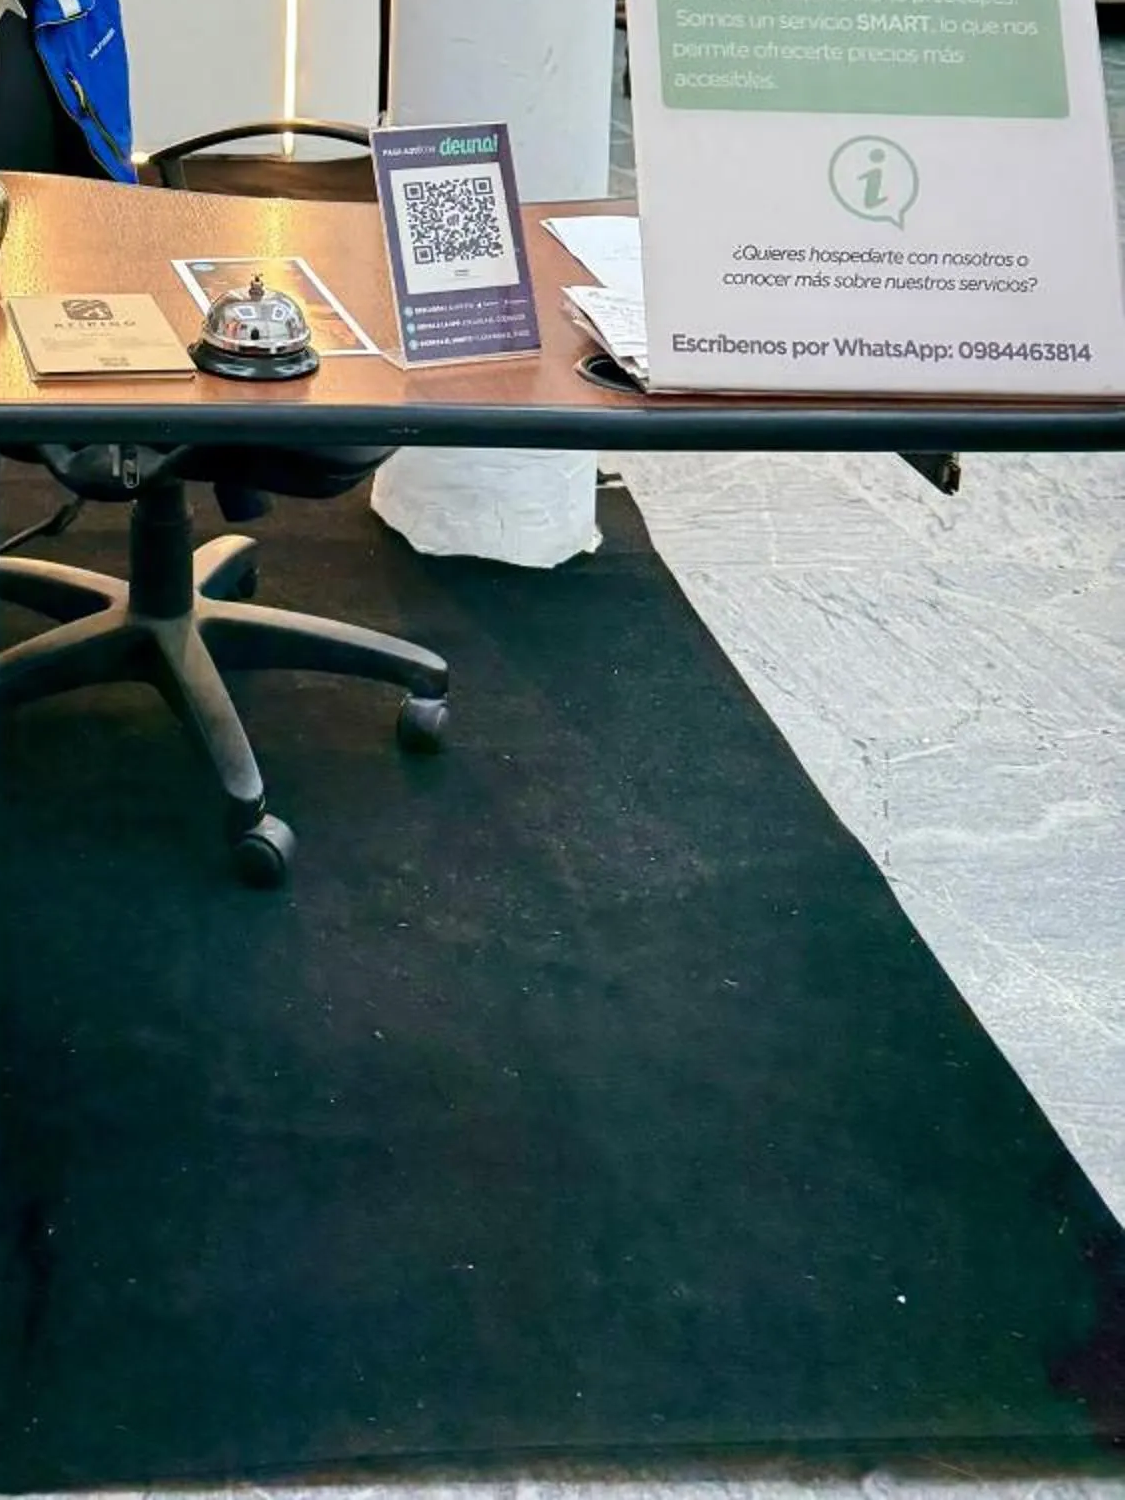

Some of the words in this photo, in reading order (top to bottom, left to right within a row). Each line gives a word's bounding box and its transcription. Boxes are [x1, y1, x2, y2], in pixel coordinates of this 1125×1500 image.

[675, 8, 746, 29] Somos
[749, 12, 776, 29] un
[778, 12, 854, 32] servicio
[940, 15, 959, 34] lo
[961, 18, 1001, 38] que
[1003, 20, 1040, 37] nos
[672, 41, 750, 61] permite
[752, 39, 844, 61] ofrecerte
[846, 45, 919, 68] precios
[922, 43, 966, 64] más
[732, 244, 806, 263] ¿Quieres
[808, 247, 904, 265] hospedarte
[907, 251, 938, 265] con
[942, 251, 1014, 267] nosotros
[1016, 254, 1030, 267] o
[722, 272, 792, 287] conocer
[794, 269, 831, 287] más
[833, 272, 882, 289] sobre
[884, 275, 956, 291] nuestros
[959, 276, 1039, 293] servicios?
[672, 333, 788, 355] Escríbenos
[792, 339, 830, 360] por
[832, 337, 954, 362] WhatsApp:
[958, 341, 1093, 363] 0984463814
